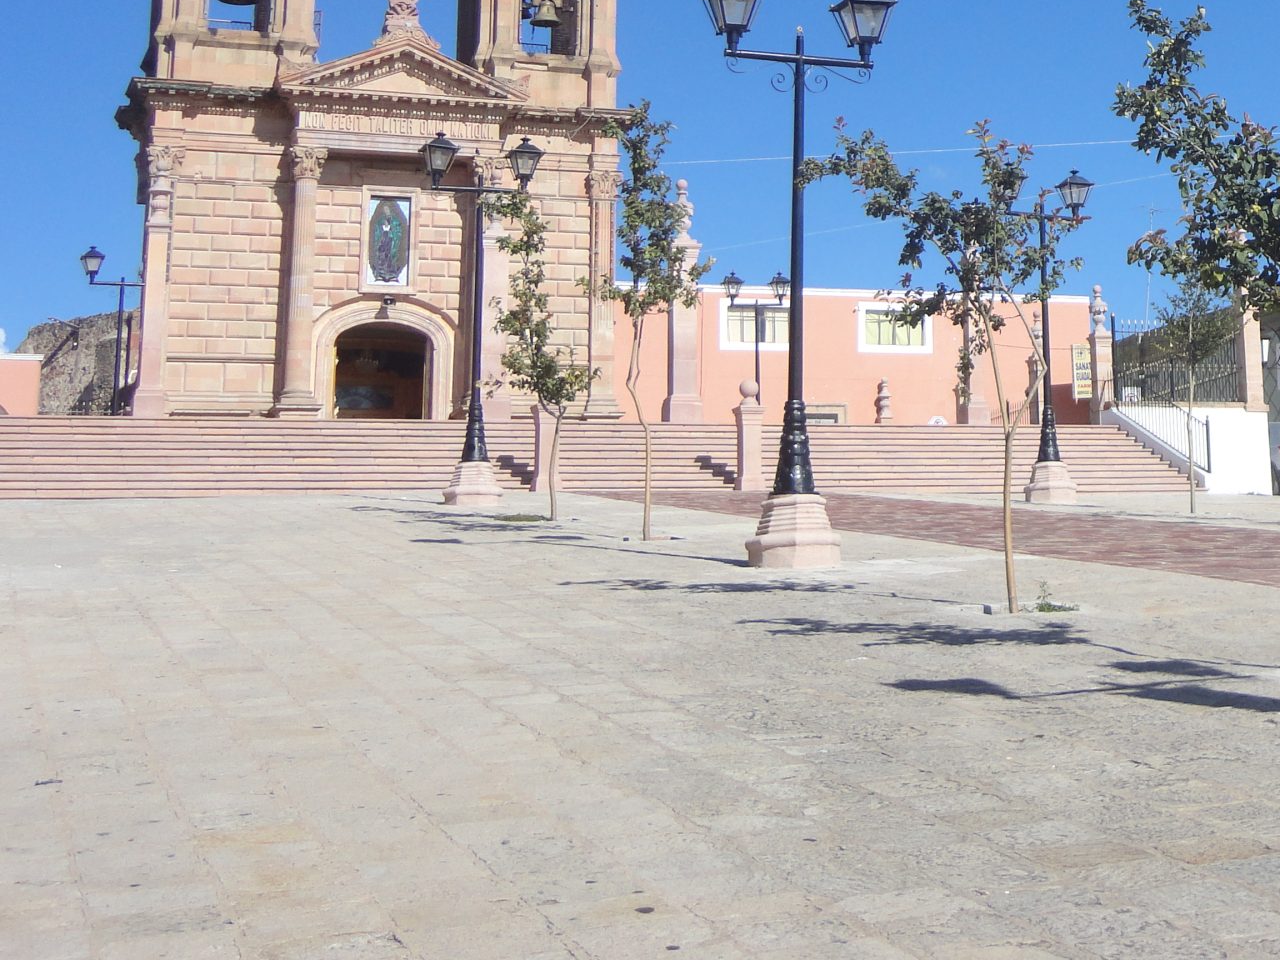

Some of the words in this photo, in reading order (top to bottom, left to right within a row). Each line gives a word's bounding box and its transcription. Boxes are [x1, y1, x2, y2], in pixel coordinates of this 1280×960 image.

[304, 112, 326, 129] NON
[331, 114, 361, 132] FECIT
[368, 117, 413, 135] TALITER
